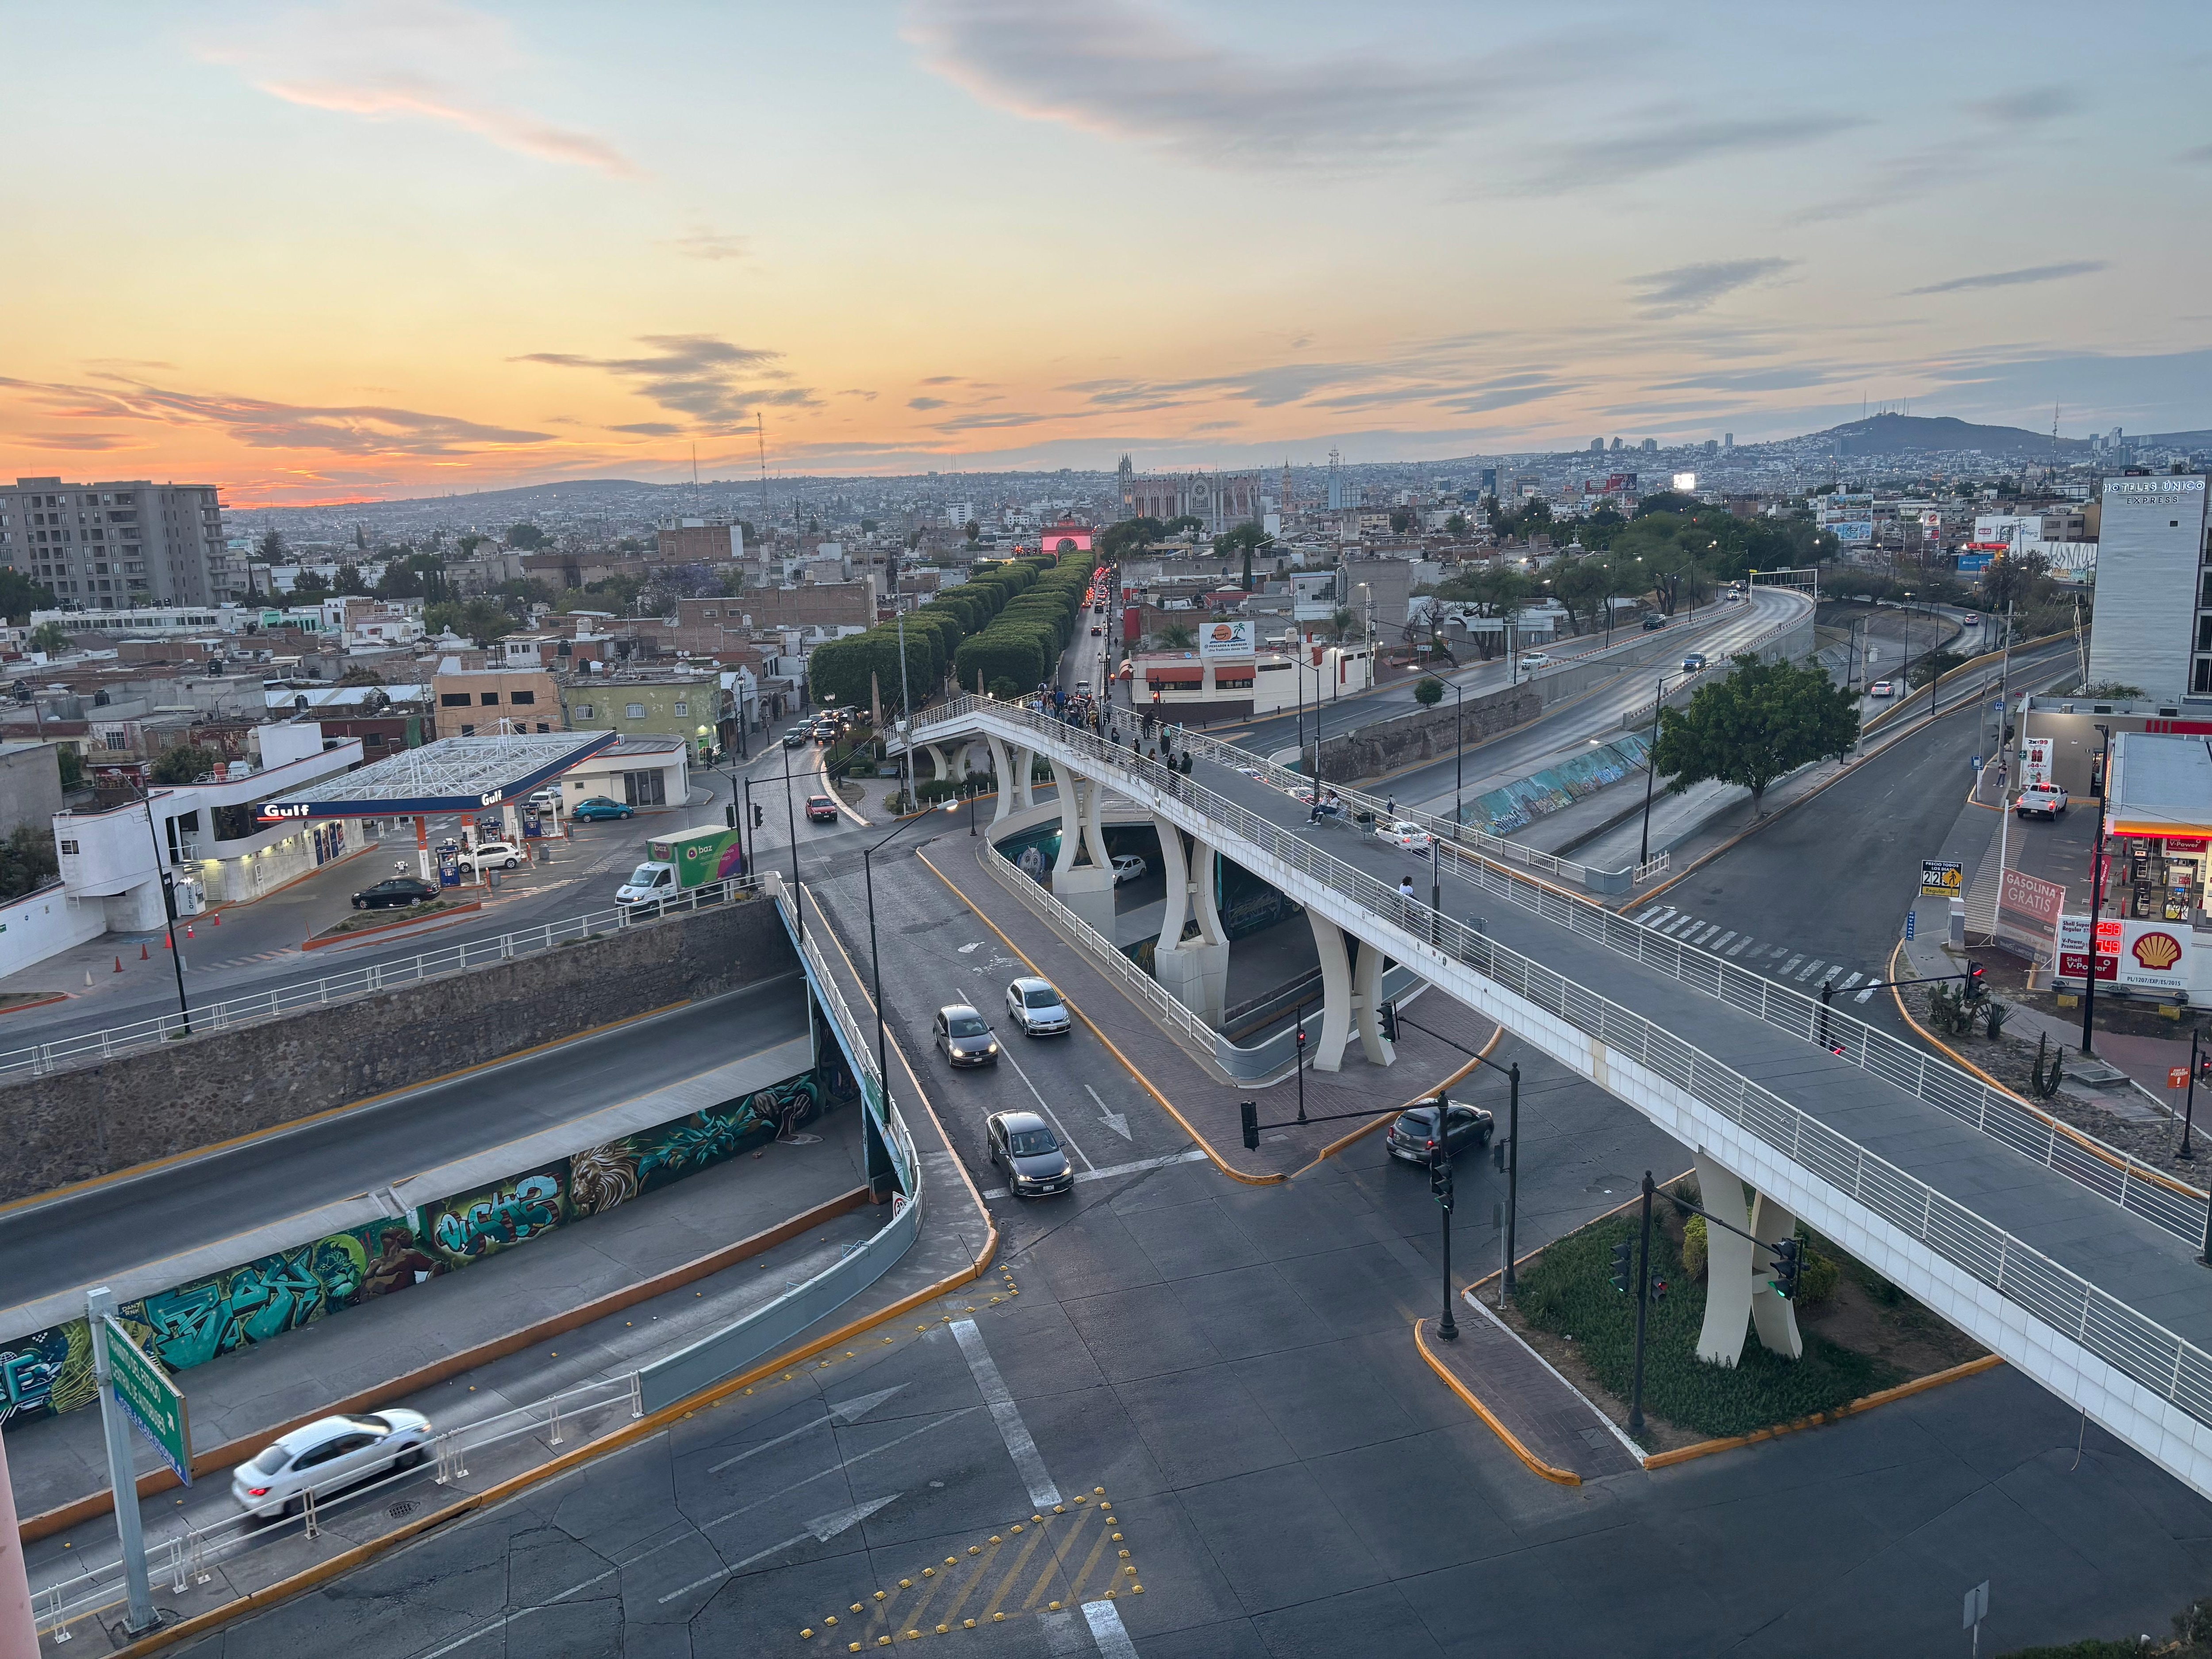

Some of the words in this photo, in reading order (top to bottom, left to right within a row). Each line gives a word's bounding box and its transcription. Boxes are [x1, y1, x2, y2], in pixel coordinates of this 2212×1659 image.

[2103, 482, 2157, 493] HOTELES
[2162, 480, 2205, 491] ÚNICO
[2127, 496, 2179, 504] EXPRESS
[481, 790, 502, 806] Gulf
[264, 804, 309, 817] Gulf
[699, 845, 712, 854] baz
[2007, 874, 2055, 898] GASOLINA
[2008, 887, 2051, 912] GRATIS
[2066, 962, 2107, 972] V-Poer
[2127, 976, 2181, 986] PL/1207/EXP/ES/2015
[122, 1301, 141, 1313] DANY
